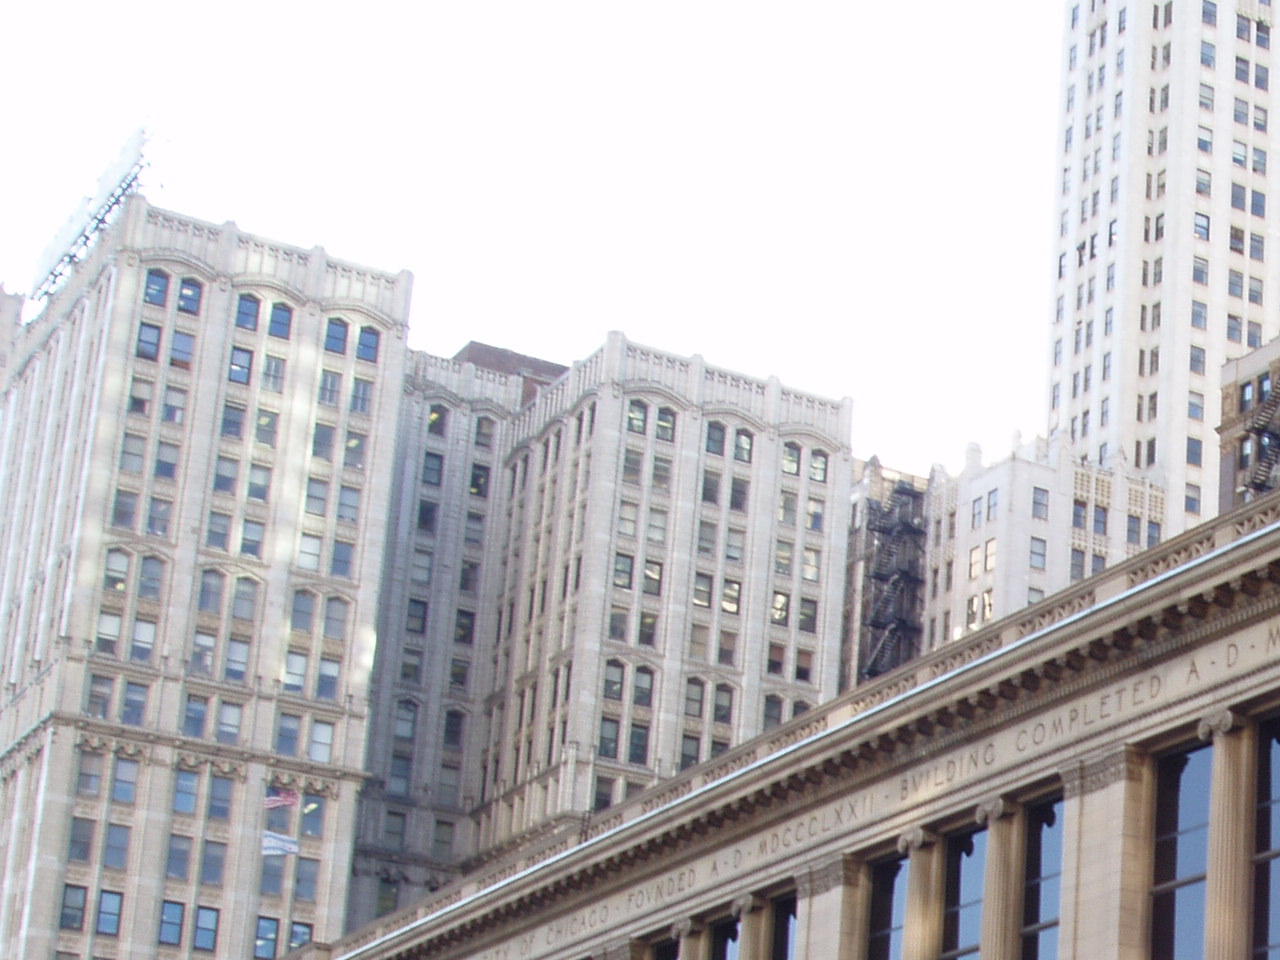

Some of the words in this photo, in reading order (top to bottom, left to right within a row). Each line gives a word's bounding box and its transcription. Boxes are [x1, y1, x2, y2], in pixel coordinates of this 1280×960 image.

[520, 933, 535, 957] OF
[546, 908, 609, 946] CHICAGO
[1016, 675, 1162, 752] COMPLETED
